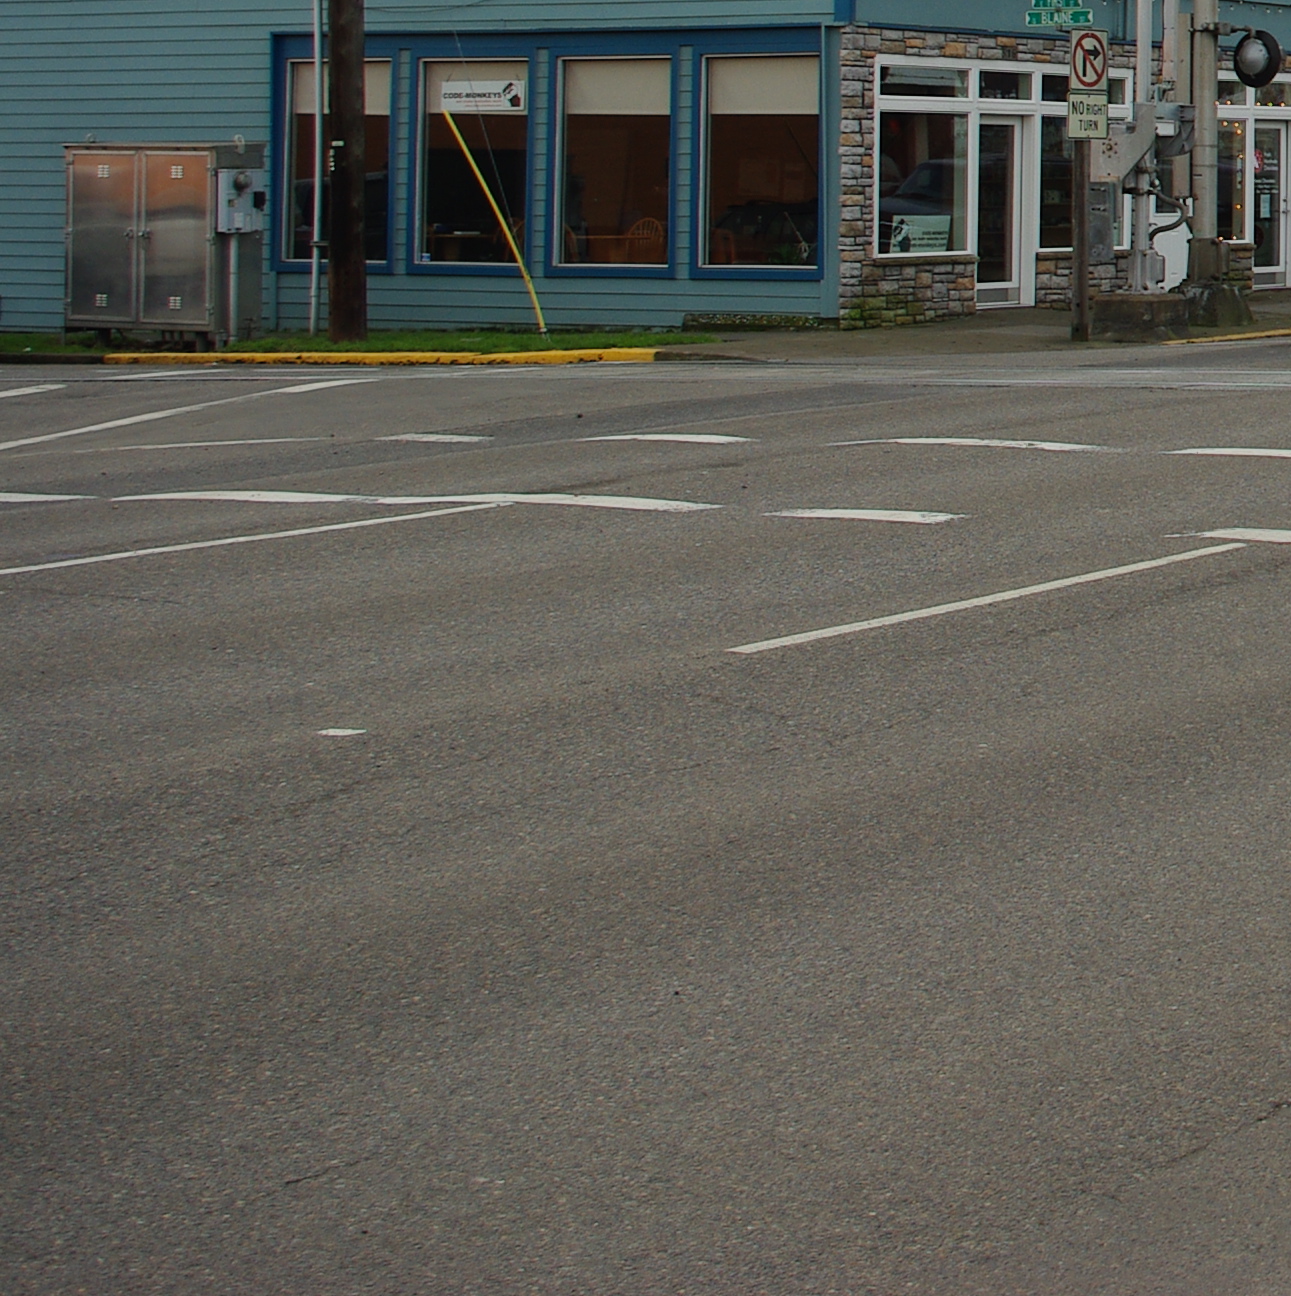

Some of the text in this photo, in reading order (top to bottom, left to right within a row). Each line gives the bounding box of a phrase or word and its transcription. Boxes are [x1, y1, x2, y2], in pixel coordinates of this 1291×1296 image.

[1041, 11, 1075, 24] BLAINE
[1072, 100, 1107, 116] NO RIGHT
[1079, 119, 1099, 131] TURN
